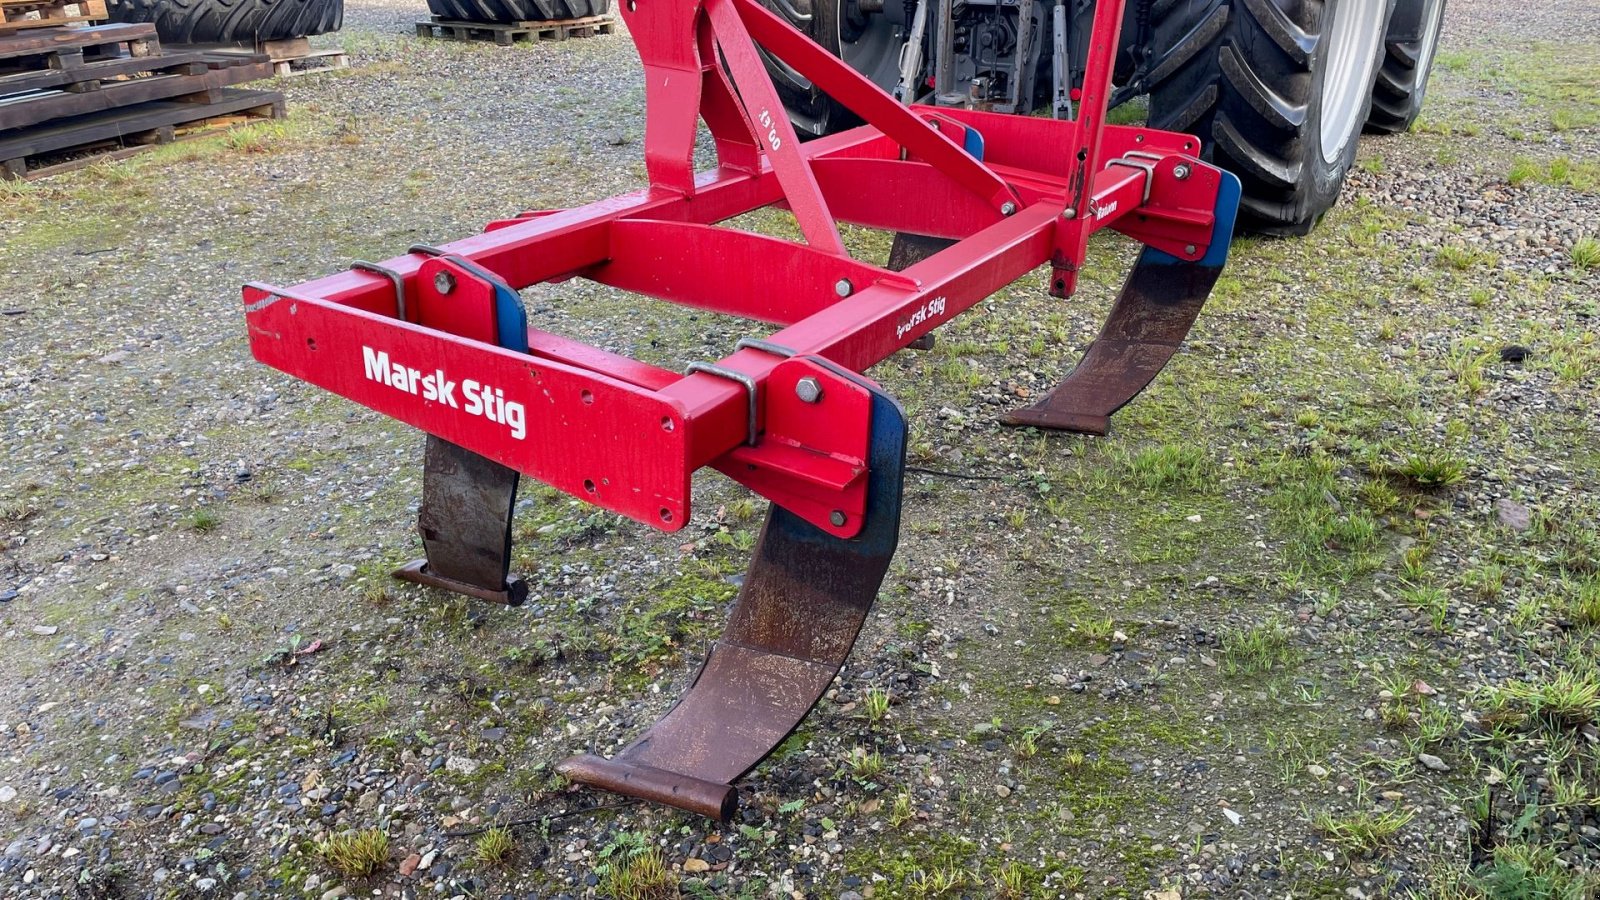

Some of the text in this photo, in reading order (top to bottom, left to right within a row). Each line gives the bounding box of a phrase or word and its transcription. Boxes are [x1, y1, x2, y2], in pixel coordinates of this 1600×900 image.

[927, 296, 946, 318] Stig
[362, 345, 527, 441] Marsk Stig
